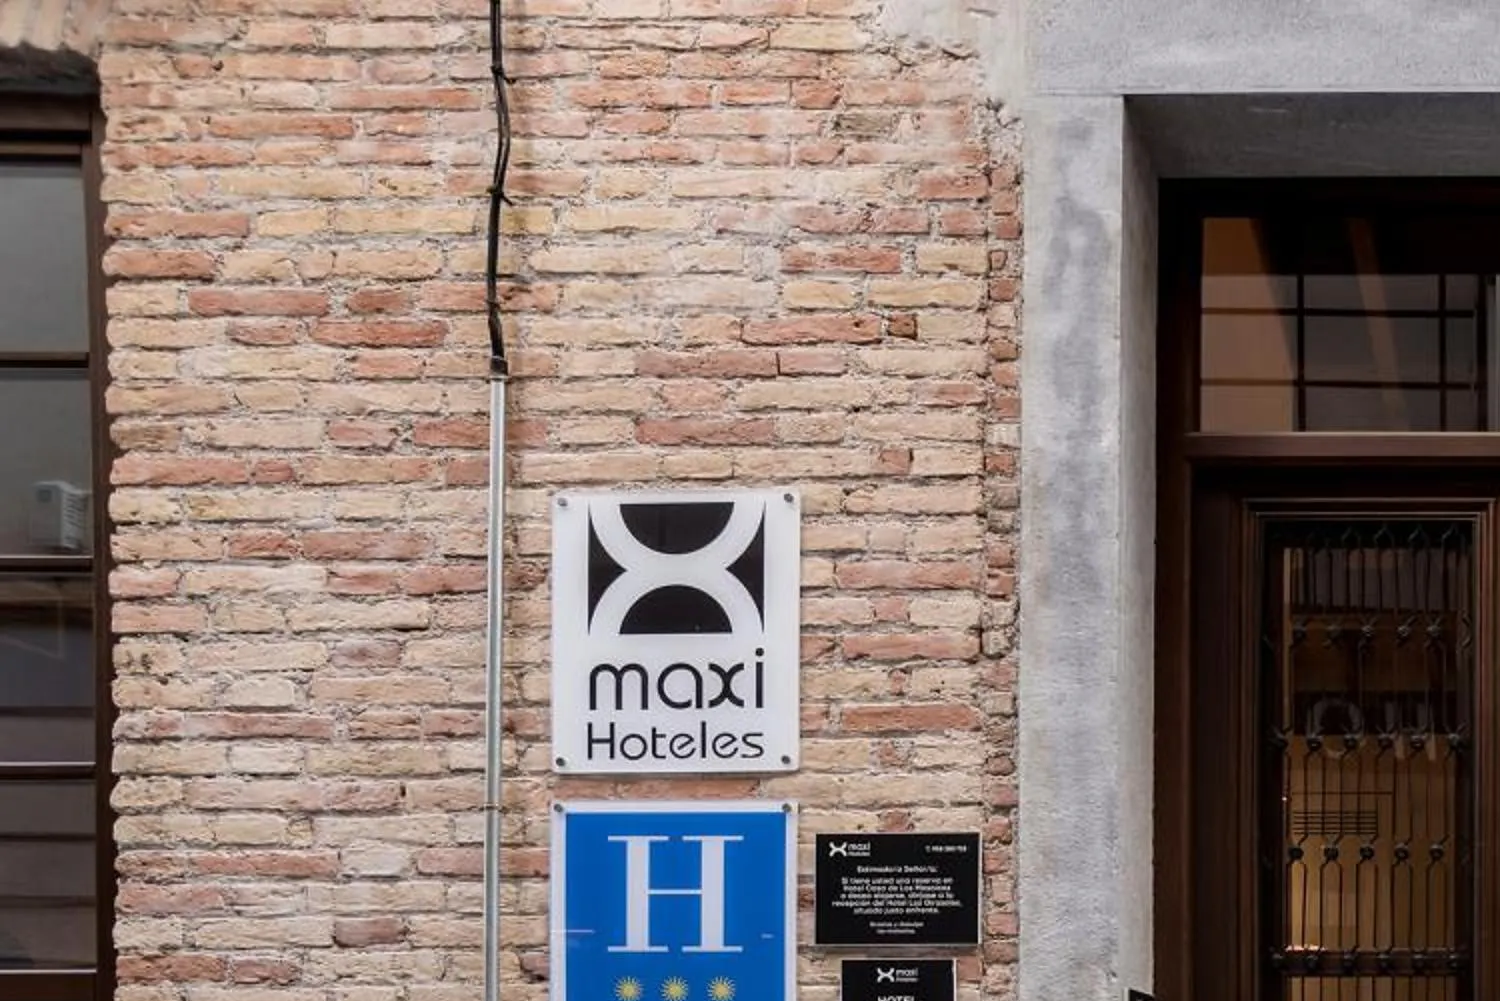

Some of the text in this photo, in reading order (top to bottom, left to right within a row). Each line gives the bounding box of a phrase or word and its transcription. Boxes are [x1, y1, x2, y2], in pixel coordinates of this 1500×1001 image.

[589, 647, 764, 710] maxi
[587, 721, 764, 760] Hoteles
[607, 835, 744, 953] H
